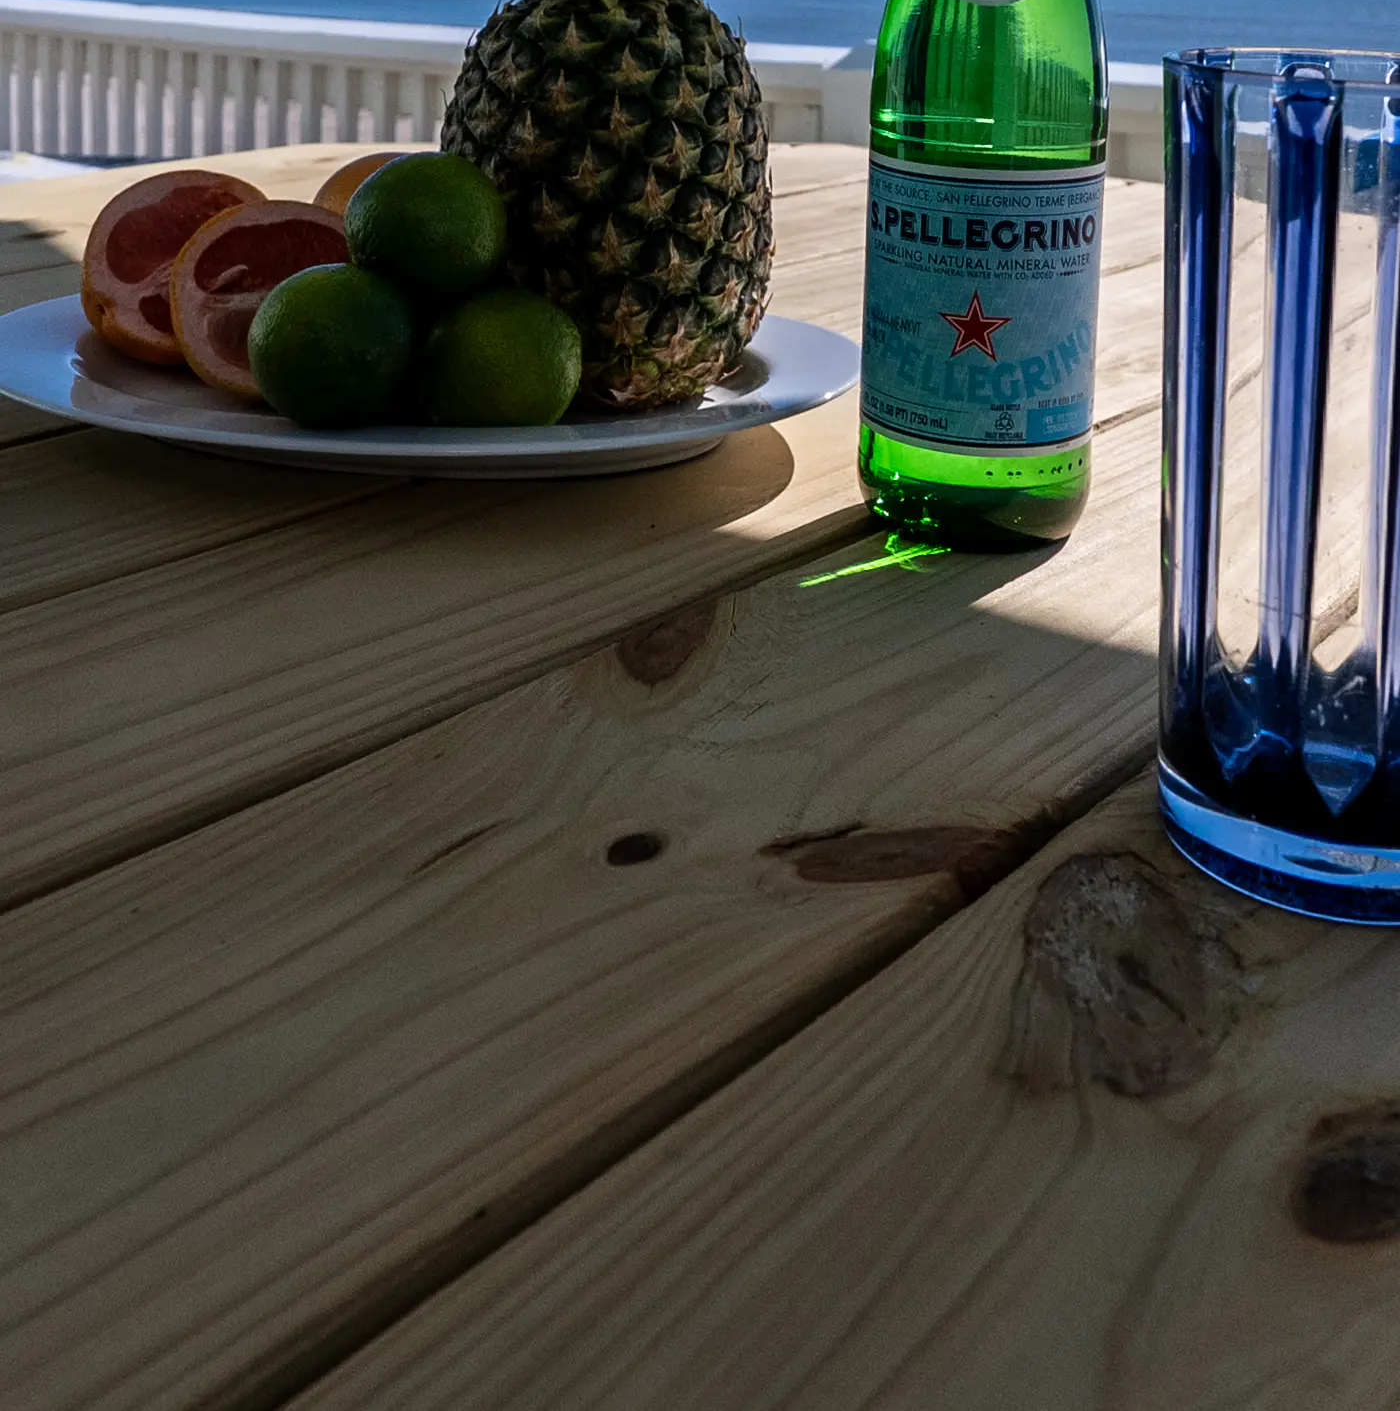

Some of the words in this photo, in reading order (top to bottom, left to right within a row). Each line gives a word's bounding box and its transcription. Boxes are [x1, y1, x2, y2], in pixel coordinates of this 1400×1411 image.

[882, 180, 893, 193] THE
[895, 183, 933, 205] SOURCE,
[936, 190, 960, 205] SAN
[964, 193, 1032, 209] PELLEGRINO
[1034, 194, 1065, 208] TERME
[870, 200, 1097, 253] S.PELLEGRINO
[873, 238, 923, 263] SPARKLING
[927, 252, 990, 272] NATURAL
[999, 256, 1056, 272] MINERAL
[1060, 252, 1090, 268] WATER
[904, 261, 931, 273] NATURAL
[933, 266, 964, 278] MINERAL
[966, 269, 991, 280] WATER
[994, 269, 1013, 281] WITH
[1031, 269, 1054, 281] ADDED
[879, 400, 894, 416] (1.58
[895, 406, 908, 423] PT)
[910, 411, 928, 426] (750
[930, 417, 948, 431] mL)
